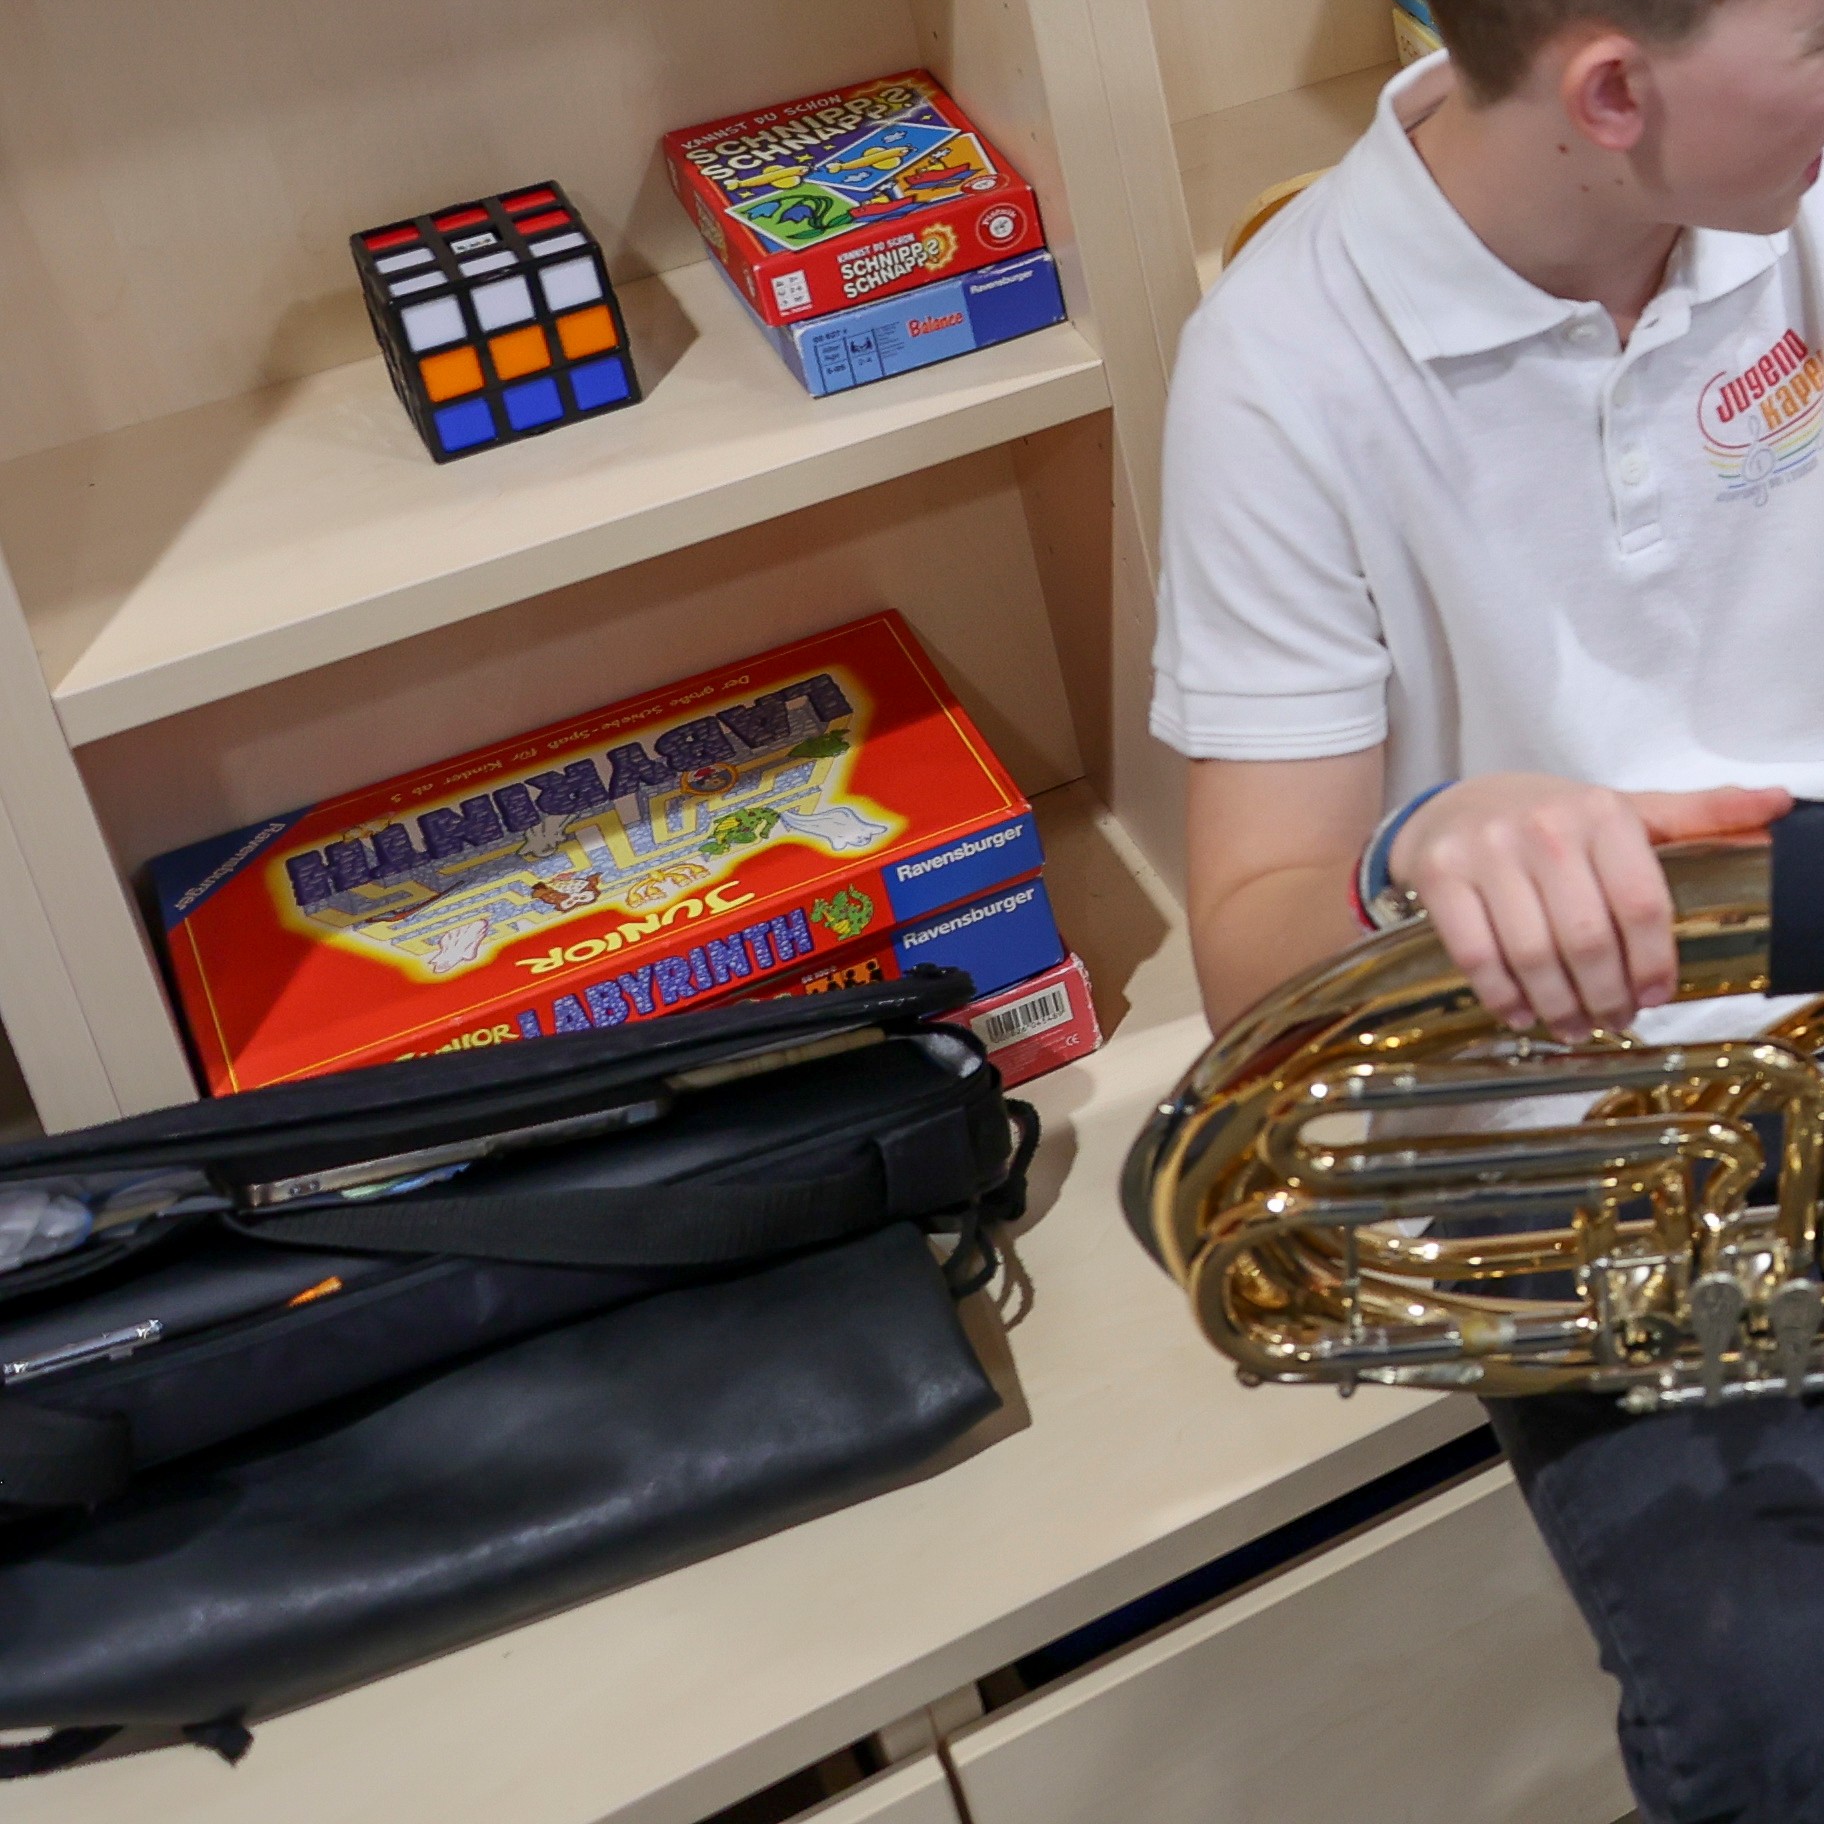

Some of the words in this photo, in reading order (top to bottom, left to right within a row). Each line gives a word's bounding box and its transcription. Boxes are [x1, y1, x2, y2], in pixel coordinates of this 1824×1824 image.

[681, 122, 750, 151] KANNST
[754, 111, 778, 126] DU
[783, 94, 843, 116] SCHON
[685, 96, 874, 166] SCHNIPP
[839, 240, 925, 281] SCHNIPP
[969, 269, 1034, 295] Ravensburger
[907, 311, 965, 338] Balance
[720, 674, 751, 693] Der
[285, 673, 855, 907] LABYRINTH
[411, 780, 435, 797] ab
[444, 759, 503, 785] Kinder
[174, 822, 287, 911] Ravensburger
[895, 822, 1025, 883] Ravensburger
[515, 879, 757, 975] JUNIOR
[902, 887, 1036, 950] Ravensburger
[395, 1022, 520, 1063] NIOR
[516, 907, 816, 1042] LABYRINTH
